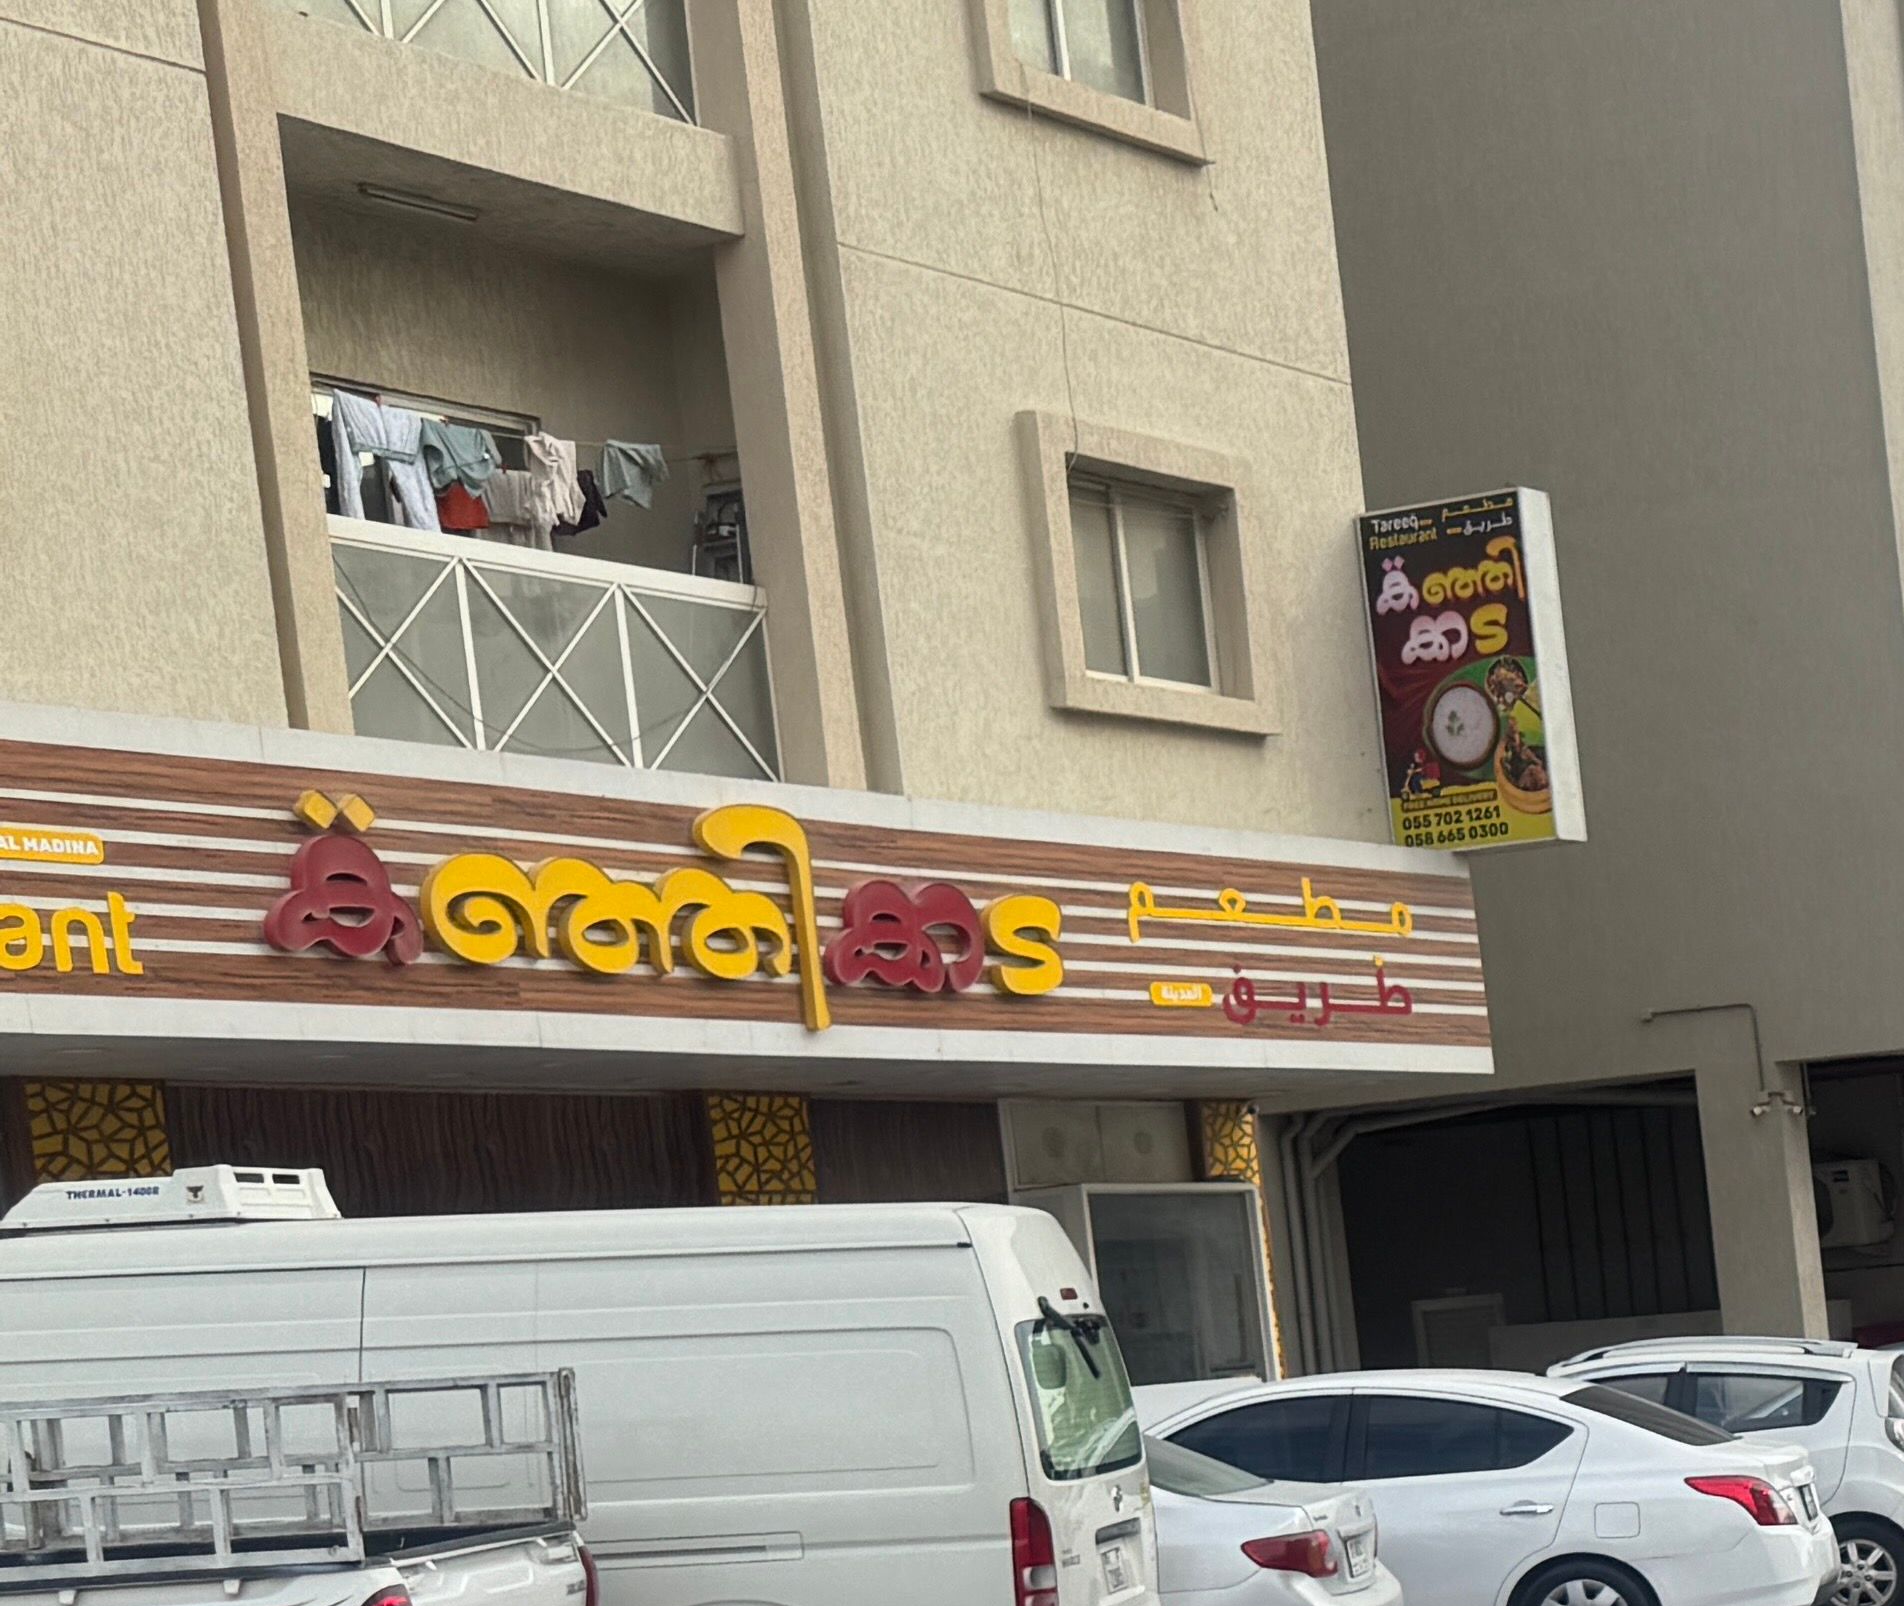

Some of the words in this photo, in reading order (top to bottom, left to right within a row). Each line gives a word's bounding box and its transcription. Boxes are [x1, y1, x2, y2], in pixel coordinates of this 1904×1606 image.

[1441, 497, 1513, 522] مطعم
[1371, 513, 1419, 534] Tareeq
[1369, 527, 1437, 550] Restaurant
[1403, 813, 1432, 830] 055
[1434, 810, 1463, 826] 702
[1465, 805, 1501, 822] 1261
[1437, 827, 1465, 843] 665
[1469, 822, 1509, 839] 0300
[22, 837, 99, 855] MADINA
[1128, 877, 1412, 943] مطعم
